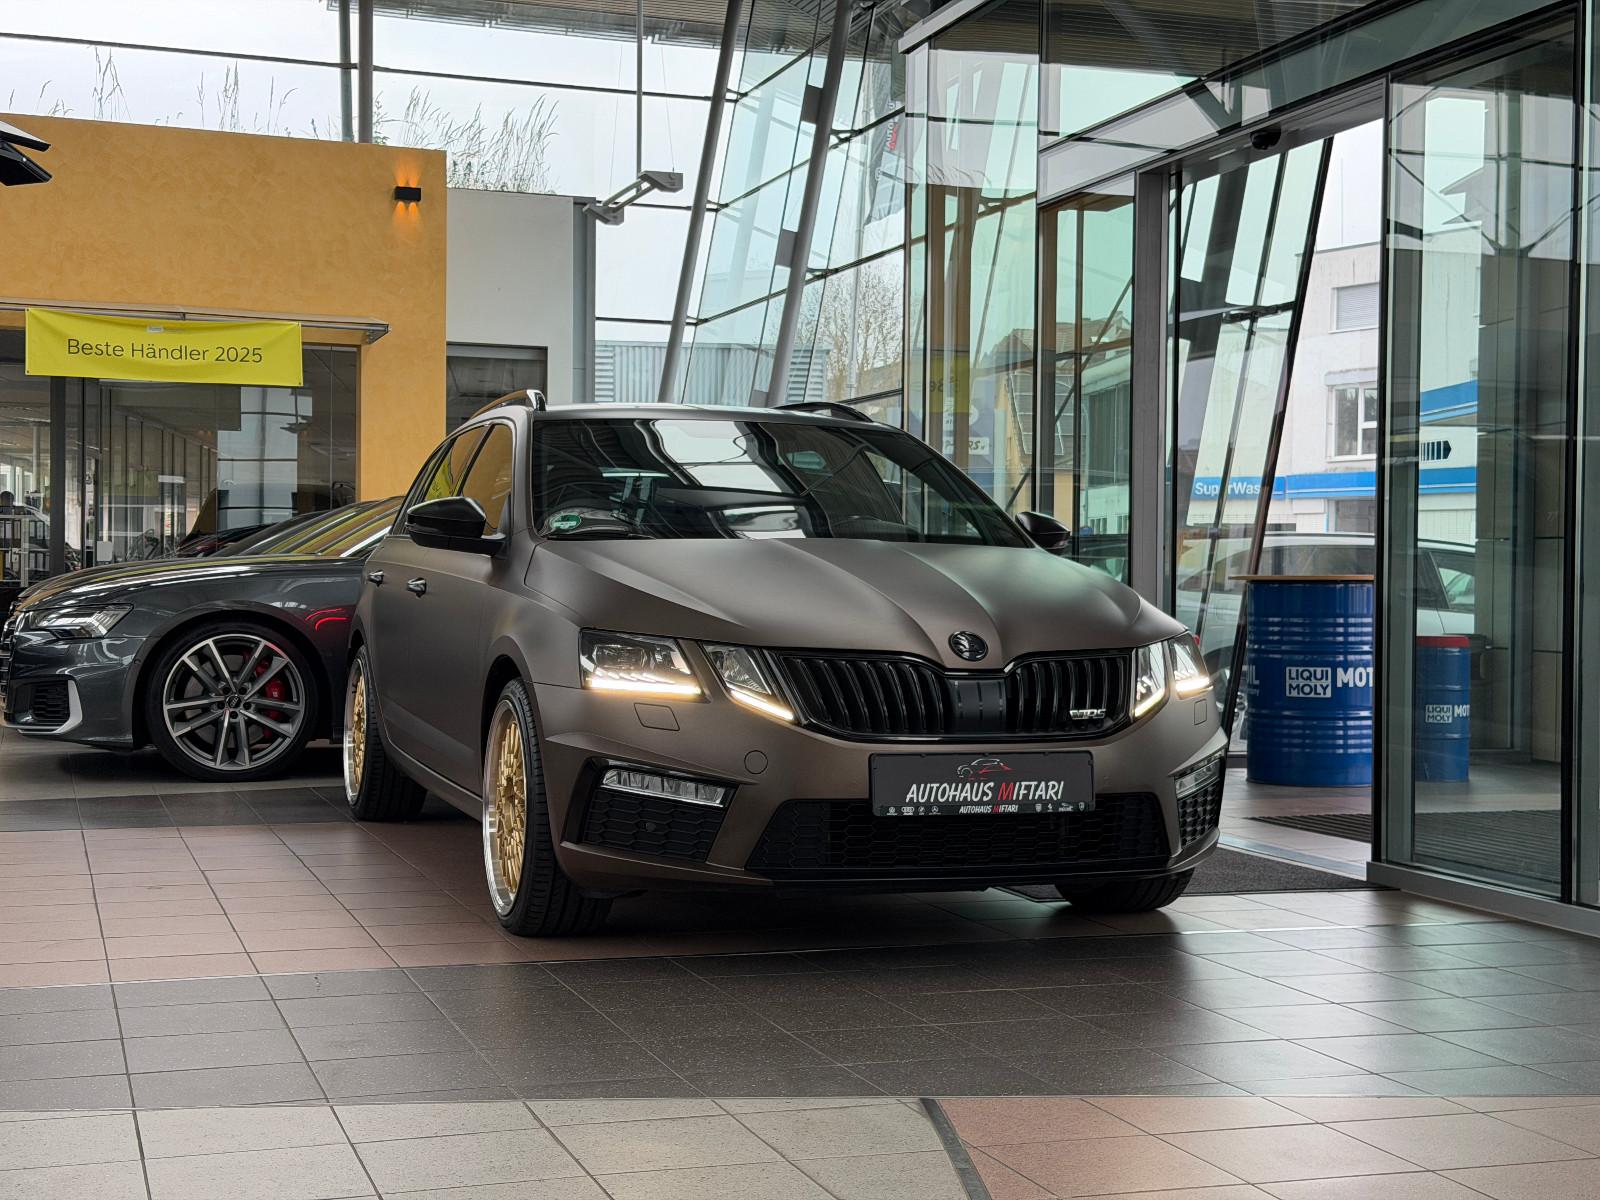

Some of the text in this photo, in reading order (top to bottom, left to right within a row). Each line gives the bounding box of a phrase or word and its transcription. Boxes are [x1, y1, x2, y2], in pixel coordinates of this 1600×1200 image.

[67, 338, 263, 363] Beste Händler 2025
[1195, 482, 1260, 497] SuprWas
[1288, 668, 1329, 681] LIQUI
[1288, 683, 1329, 696] MOLY
[905, 781, 1064, 803] AUTOHAUS MIFTARI
[959, 804, 1019, 814] AUTOHAUS MIFTARI
